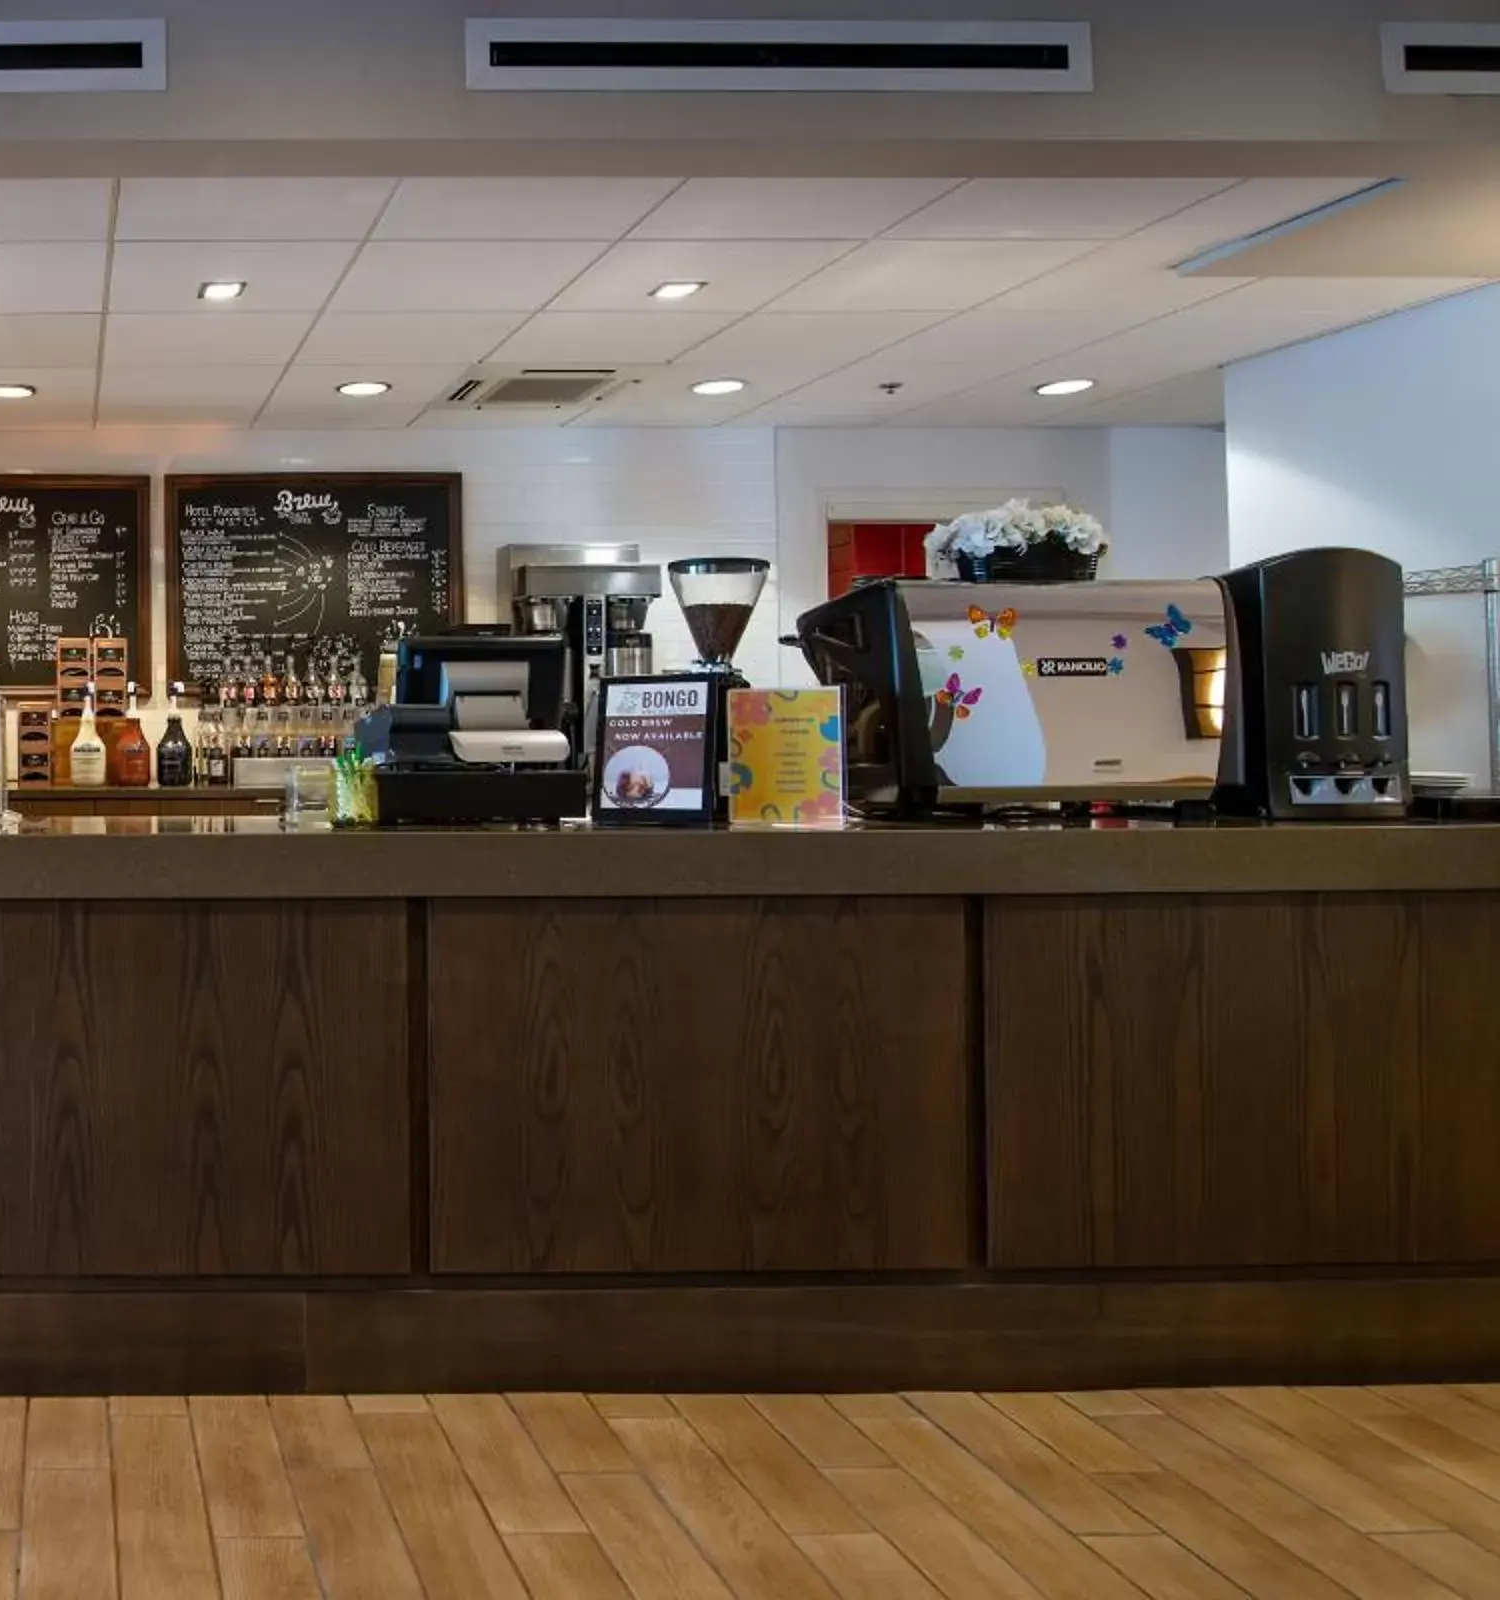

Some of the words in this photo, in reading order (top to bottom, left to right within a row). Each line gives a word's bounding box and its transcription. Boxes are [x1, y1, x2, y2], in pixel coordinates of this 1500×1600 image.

[1057, 661, 1106, 672] RANCILIO
[642, 689, 699, 709] BONGO
[609, 719, 639, 728] COLD
[641, 718, 672, 727] BREW
[615, 732, 641, 741] NOW
[643, 731, 705, 740] AVAILABLE
